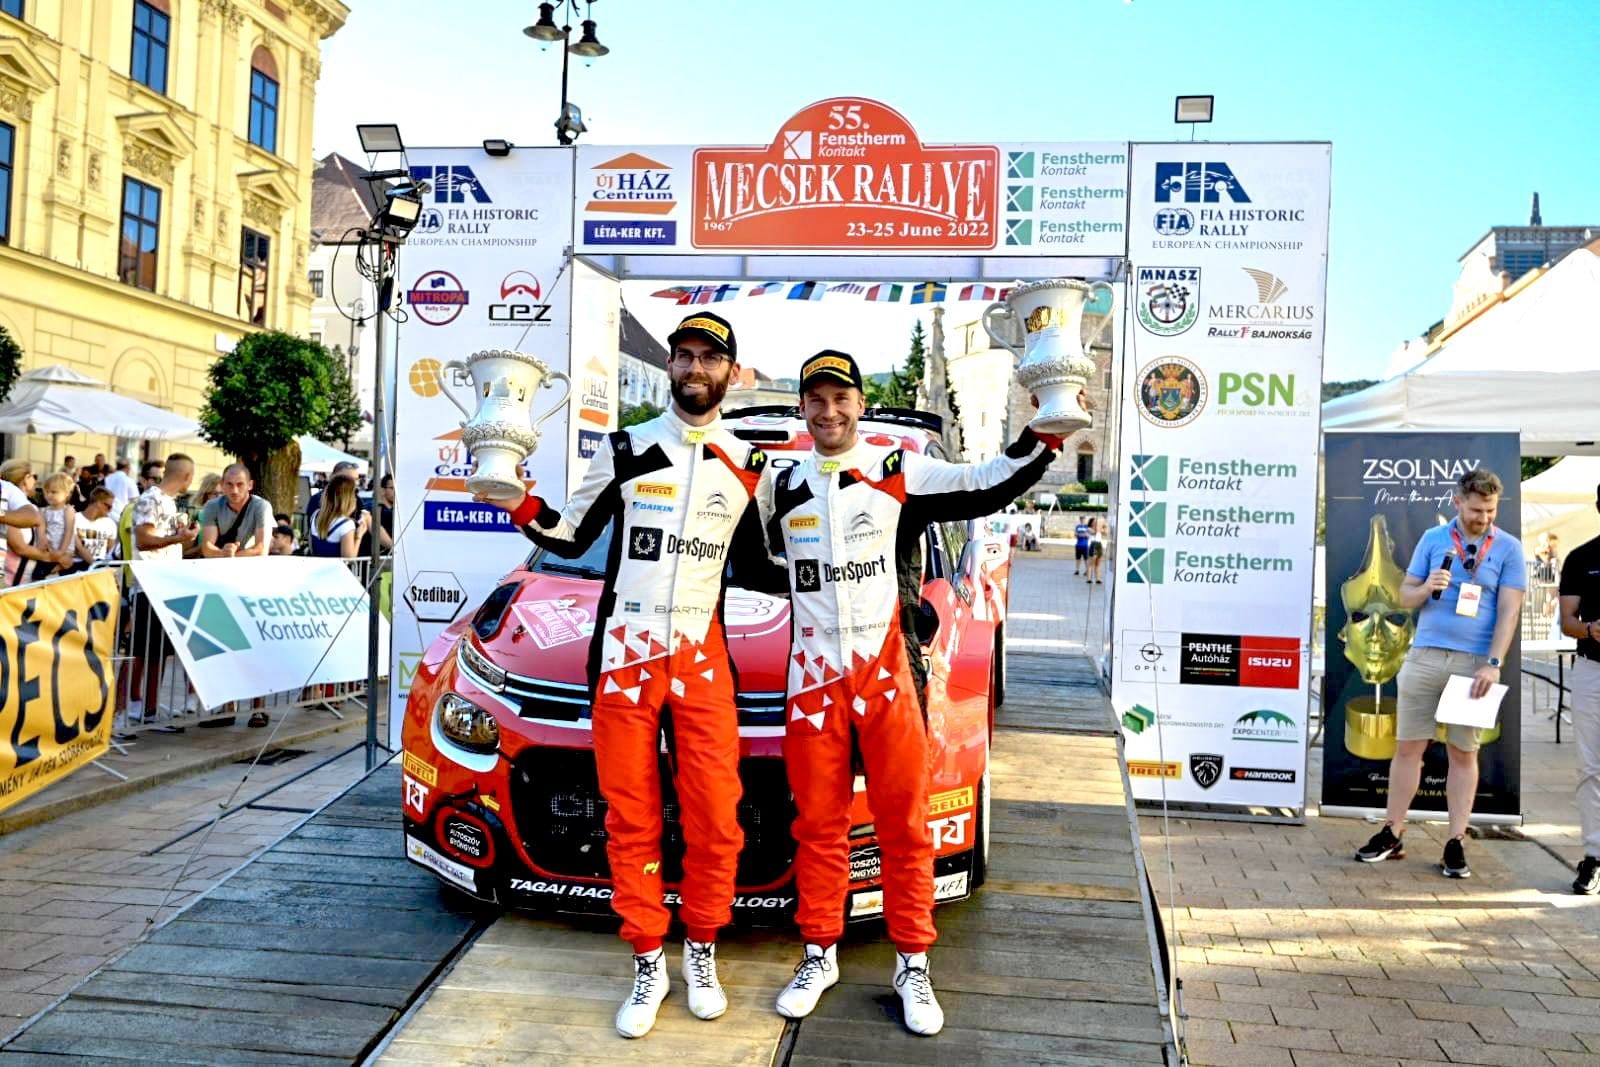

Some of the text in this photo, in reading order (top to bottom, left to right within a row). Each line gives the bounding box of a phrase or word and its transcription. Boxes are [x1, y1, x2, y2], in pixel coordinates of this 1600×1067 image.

[828, 105, 870, 130] 55.
[819, 131, 906, 145] Fenstherm
[818, 145, 867, 157] Kontakt
[1042, 152, 1126, 164] Fenstherm
[1040, 165, 1088, 176] Kontakt
[616, 169, 672, 190] HÁZ
[592, 189, 673, 200] Centrum
[703, 159, 987, 222] MECSEK RALLYE
[1040, 186, 1125, 198] Fenstherm
[1039, 199, 1087, 210] Kontakt
[448, 208, 539, 221] FIA HISTORIC
[1200, 209, 1305, 222] FIA HISTORIC
[447, 223, 491, 234] RALLY
[594, 224, 667, 239] LÉTA-KER KFT.
[703, 221, 733, 232] 1967
[846, 222, 990, 237] 23-25 June 2022
[1039, 220, 1124, 232] Fenstherm
[1200, 224, 1249, 236] RALLY
[407, 238, 538, 248] EUROPEAN CHAMPIONSHIP
[1038, 232, 1086, 243] Kontakt
[1152, 240, 1304, 251] EUROPEAN CHAMPIONSHIP
[1140, 269, 1198, 281] MNASZ
[1208, 304, 1315, 320] MERCARIUS
[1251, 328, 1313, 340] BAJNOKSÁG
[1217, 372, 1295, 407] PSN
[1179, 457, 1297, 478] Fenstherm
[1177, 475, 1243, 491] Kontakt
[437, 507, 493, 523] LÉTA-KER
[1177, 504, 1295, 524] Fenstherm
[1175, 522, 1241, 538] Kontakt
[667, 534, 726, 562] DevSport
[1175, 551, 1293, 571] Fenstherm
[824, 555, 887, 584] DevSport
[1173, 569, 1240, 584] Kontakt
[411, 585, 460, 603] Szedibau
[655, 604, 711, 617] BARTH
[256, 617, 333, 641] Kontakt
[1189, 642, 1232, 653] PENTHE
[1191, 653, 1231, 664] Autóház
[1247, 657, 1293, 668] ISUZU
[509, 877, 567, 896] TAGAI
